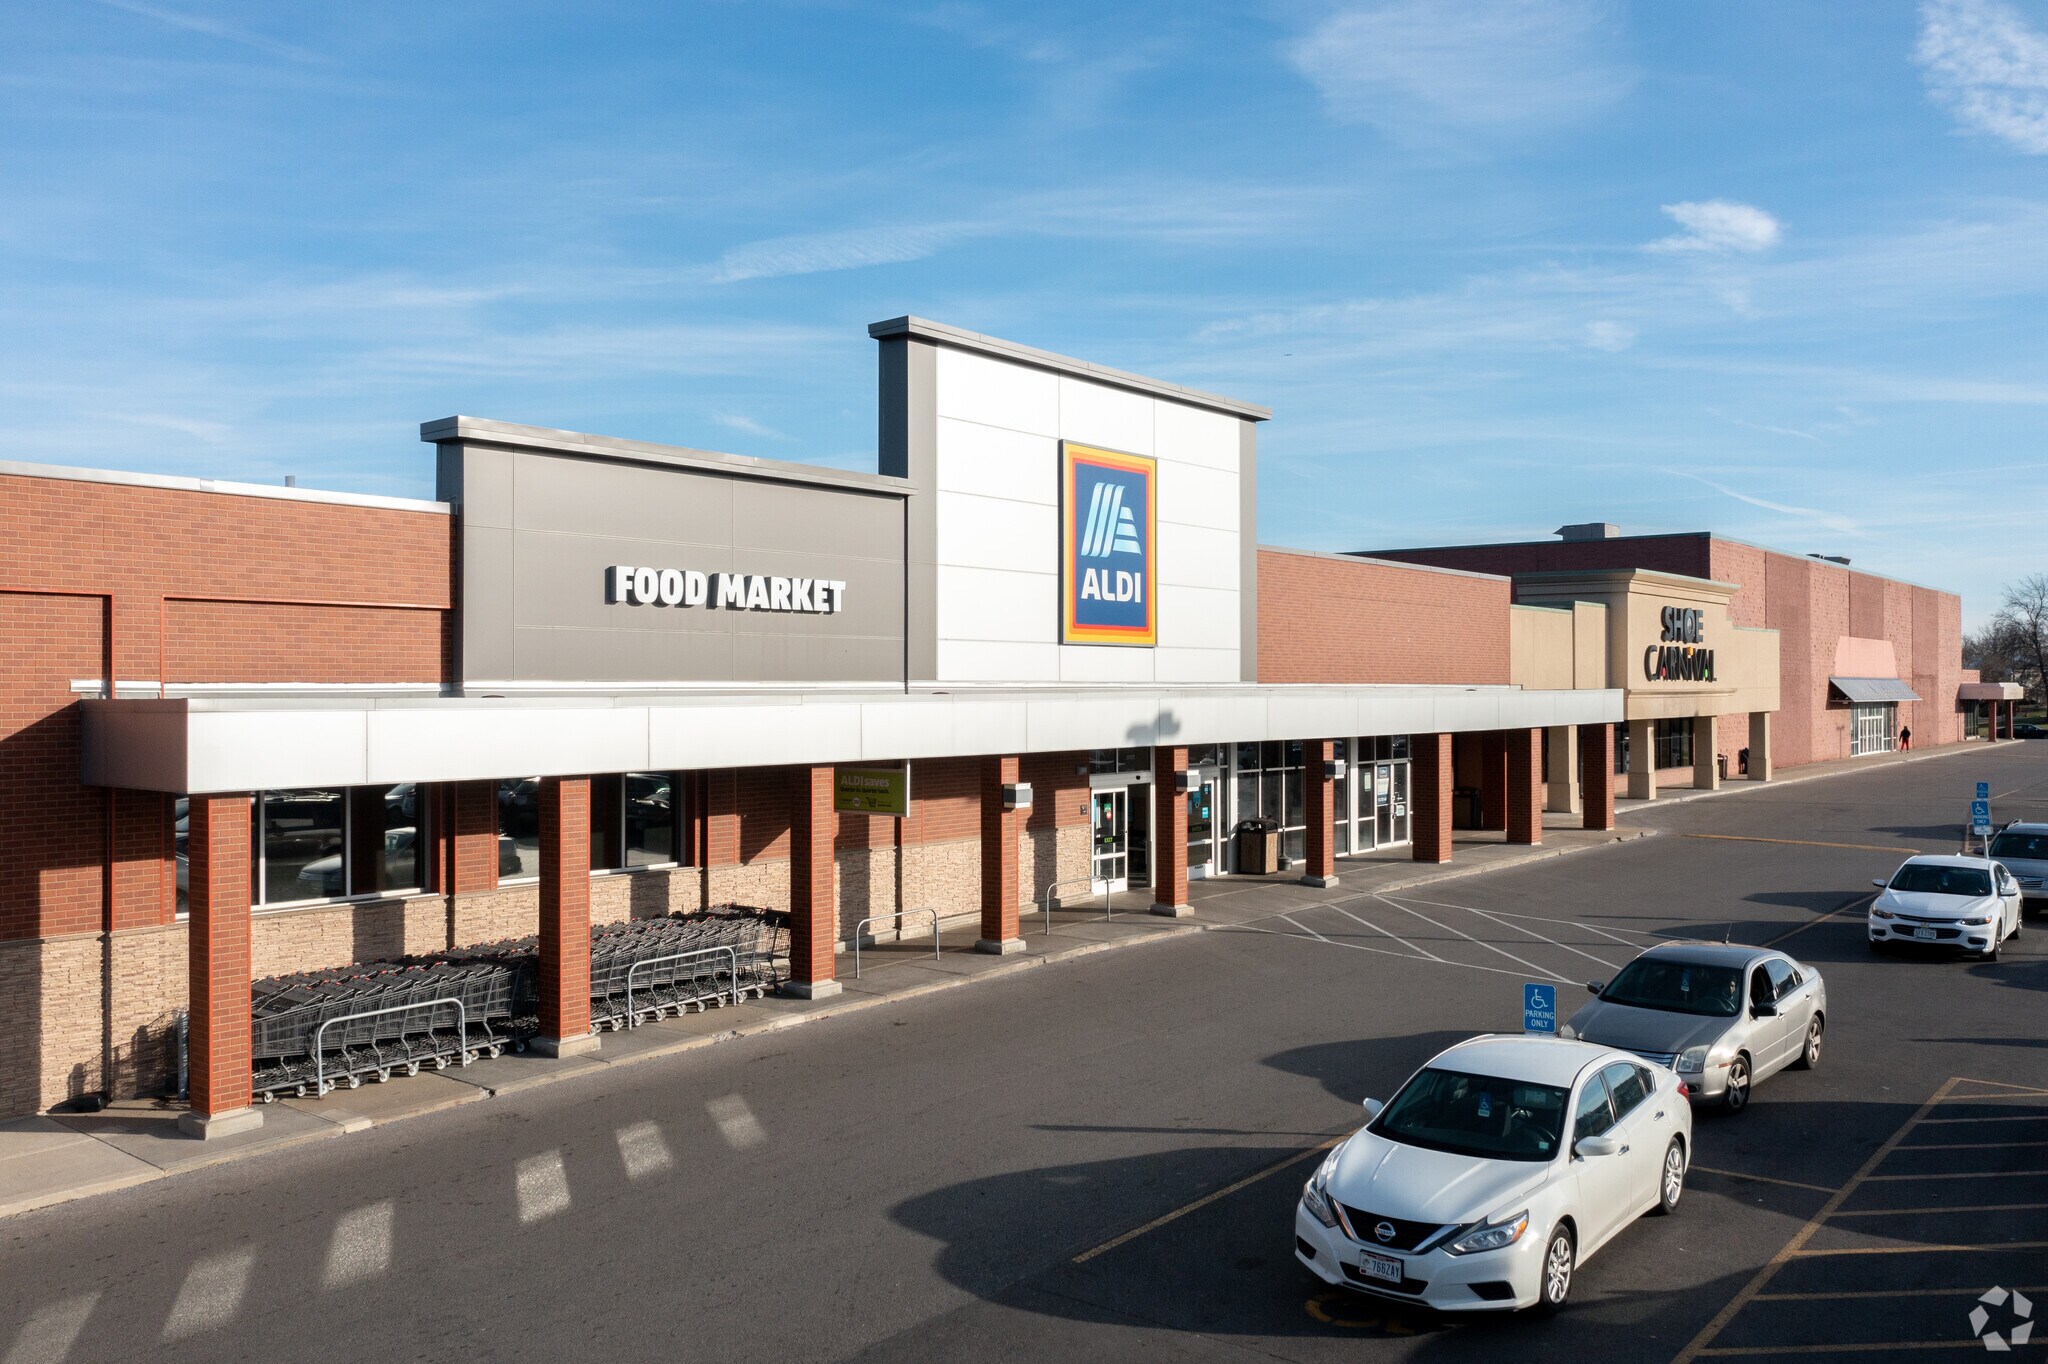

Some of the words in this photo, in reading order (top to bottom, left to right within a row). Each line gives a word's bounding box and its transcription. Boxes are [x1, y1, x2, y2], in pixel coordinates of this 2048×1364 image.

[612, 565, 708, 606] FOOD
[714, 572, 846, 613] MARKET
[1080, 567, 1142, 603] ALDI
[1660, 605, 1704, 643] SHOE
[1643, 644, 1718, 683] CARNIVAL
[1525, 1009, 1555, 1020] PARKING
[1530, 1018, 1549, 1028] ONLY
